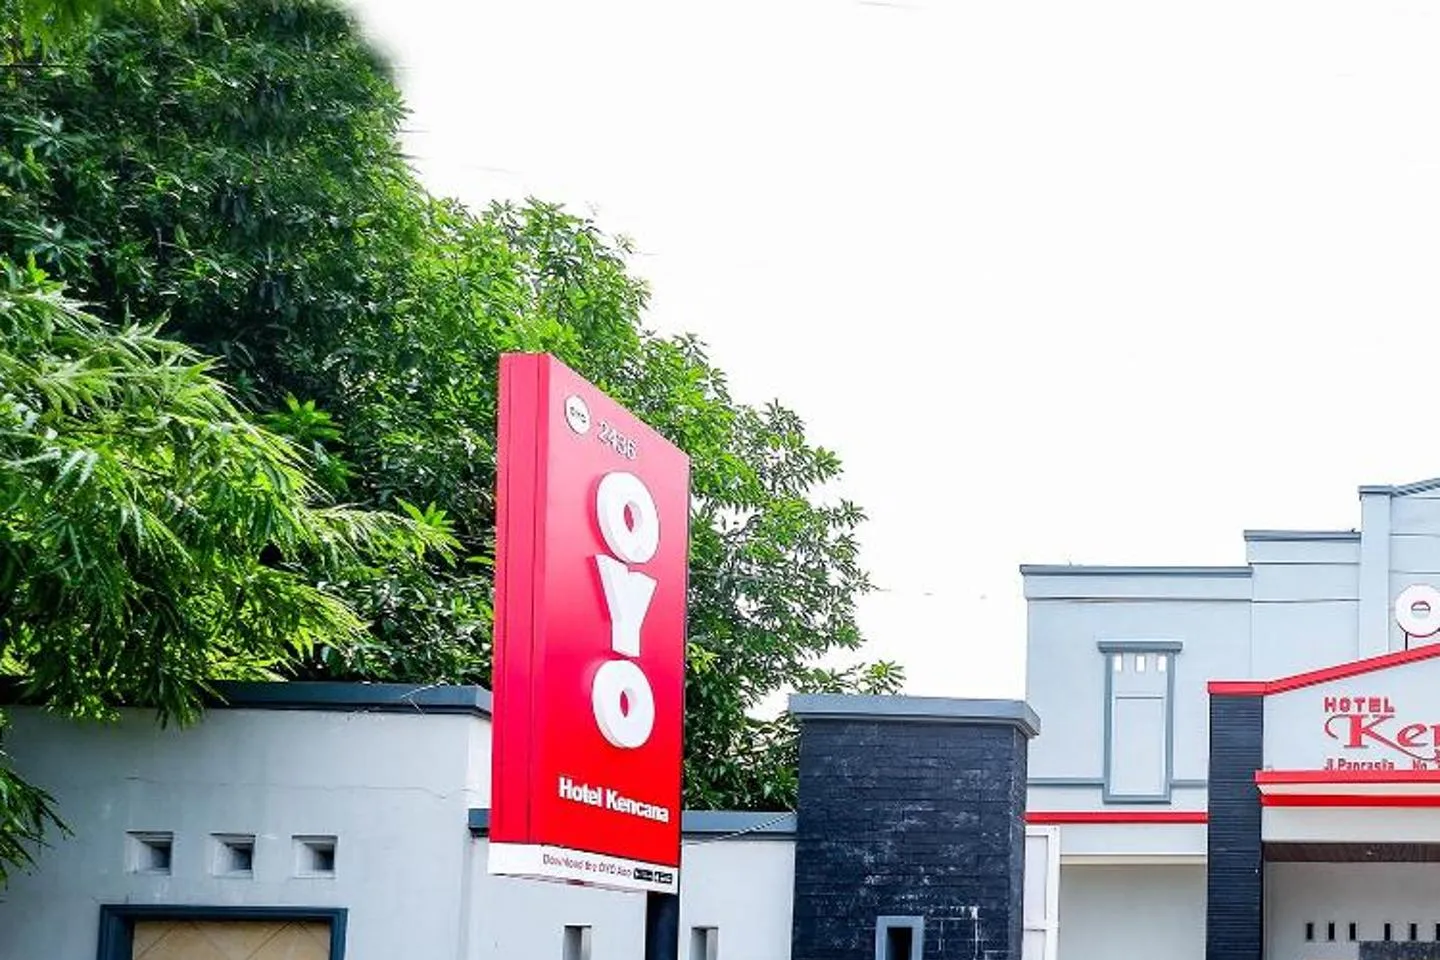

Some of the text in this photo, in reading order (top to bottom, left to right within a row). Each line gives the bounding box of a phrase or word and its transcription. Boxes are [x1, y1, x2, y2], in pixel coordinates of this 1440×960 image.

[592, 470, 660, 750] OYO
[1323, 696, 1395, 713] HOTEL
[558, 776, 669, 823] Hotel Kencana
